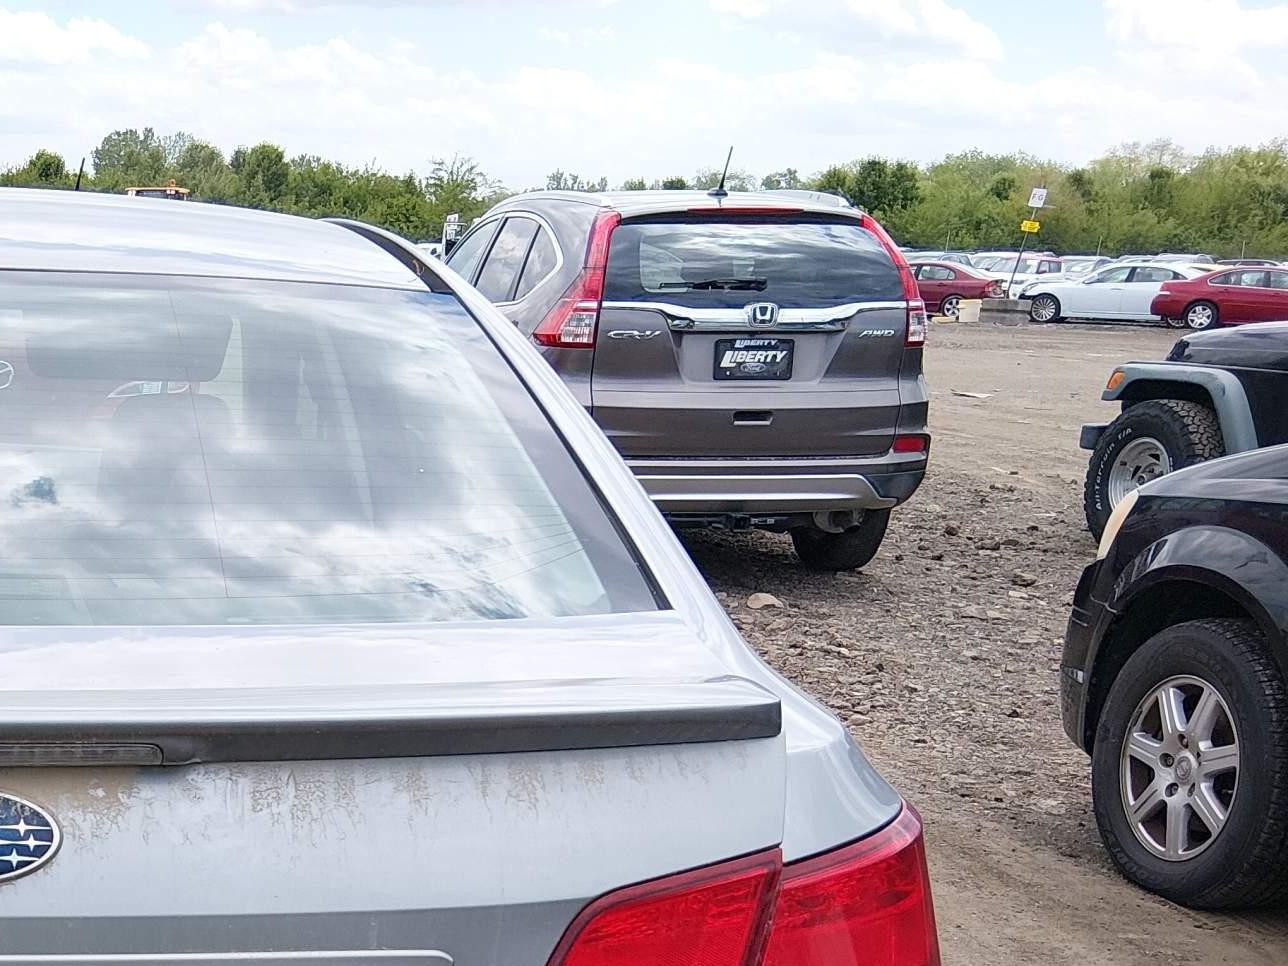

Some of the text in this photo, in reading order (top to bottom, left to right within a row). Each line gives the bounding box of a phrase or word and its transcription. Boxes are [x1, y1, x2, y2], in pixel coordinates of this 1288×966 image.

[858, 329, 895, 338] AWD
[734, 339, 778, 348] LIBERTY
[720, 350, 788, 368] LIBERTY
